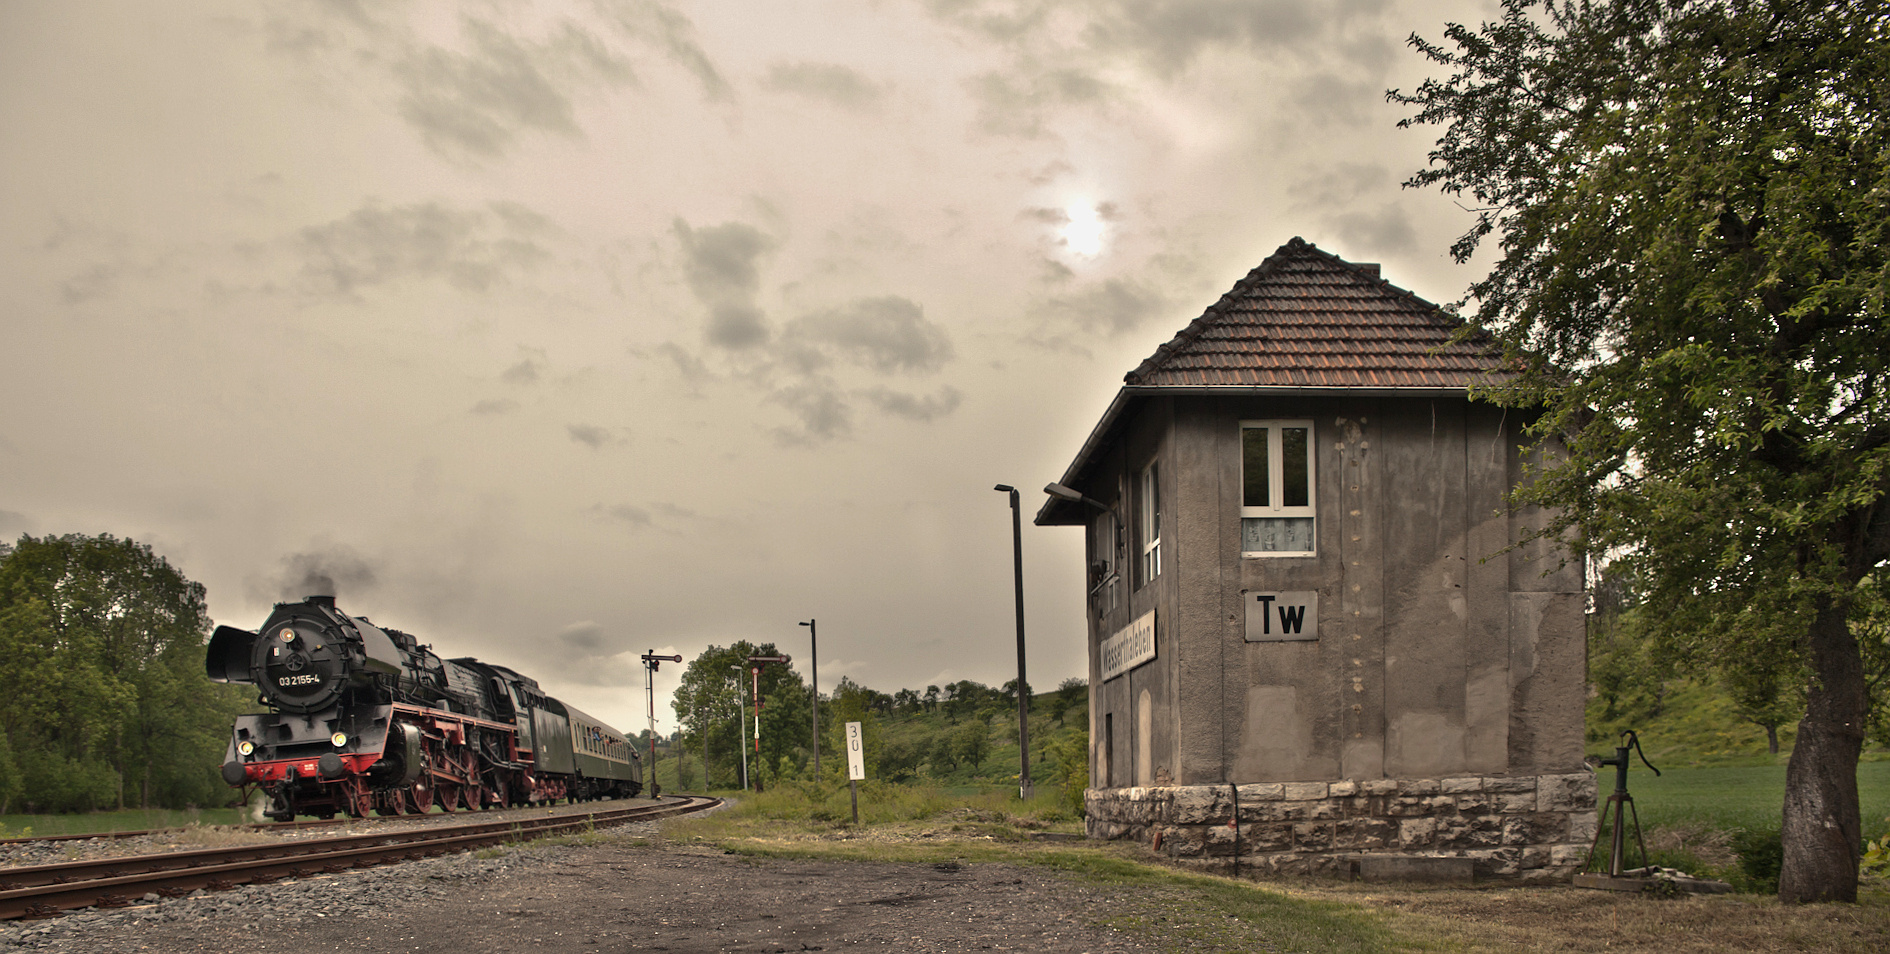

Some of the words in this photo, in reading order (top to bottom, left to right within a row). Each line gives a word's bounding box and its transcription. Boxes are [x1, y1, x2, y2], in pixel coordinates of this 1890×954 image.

[1257, 595, 1306, 634] Tw
[1103, 621, 1151, 674] Wasserthaleben
[279, 677, 290, 687] 03
[291, 674, 320, 686] 2155-4
